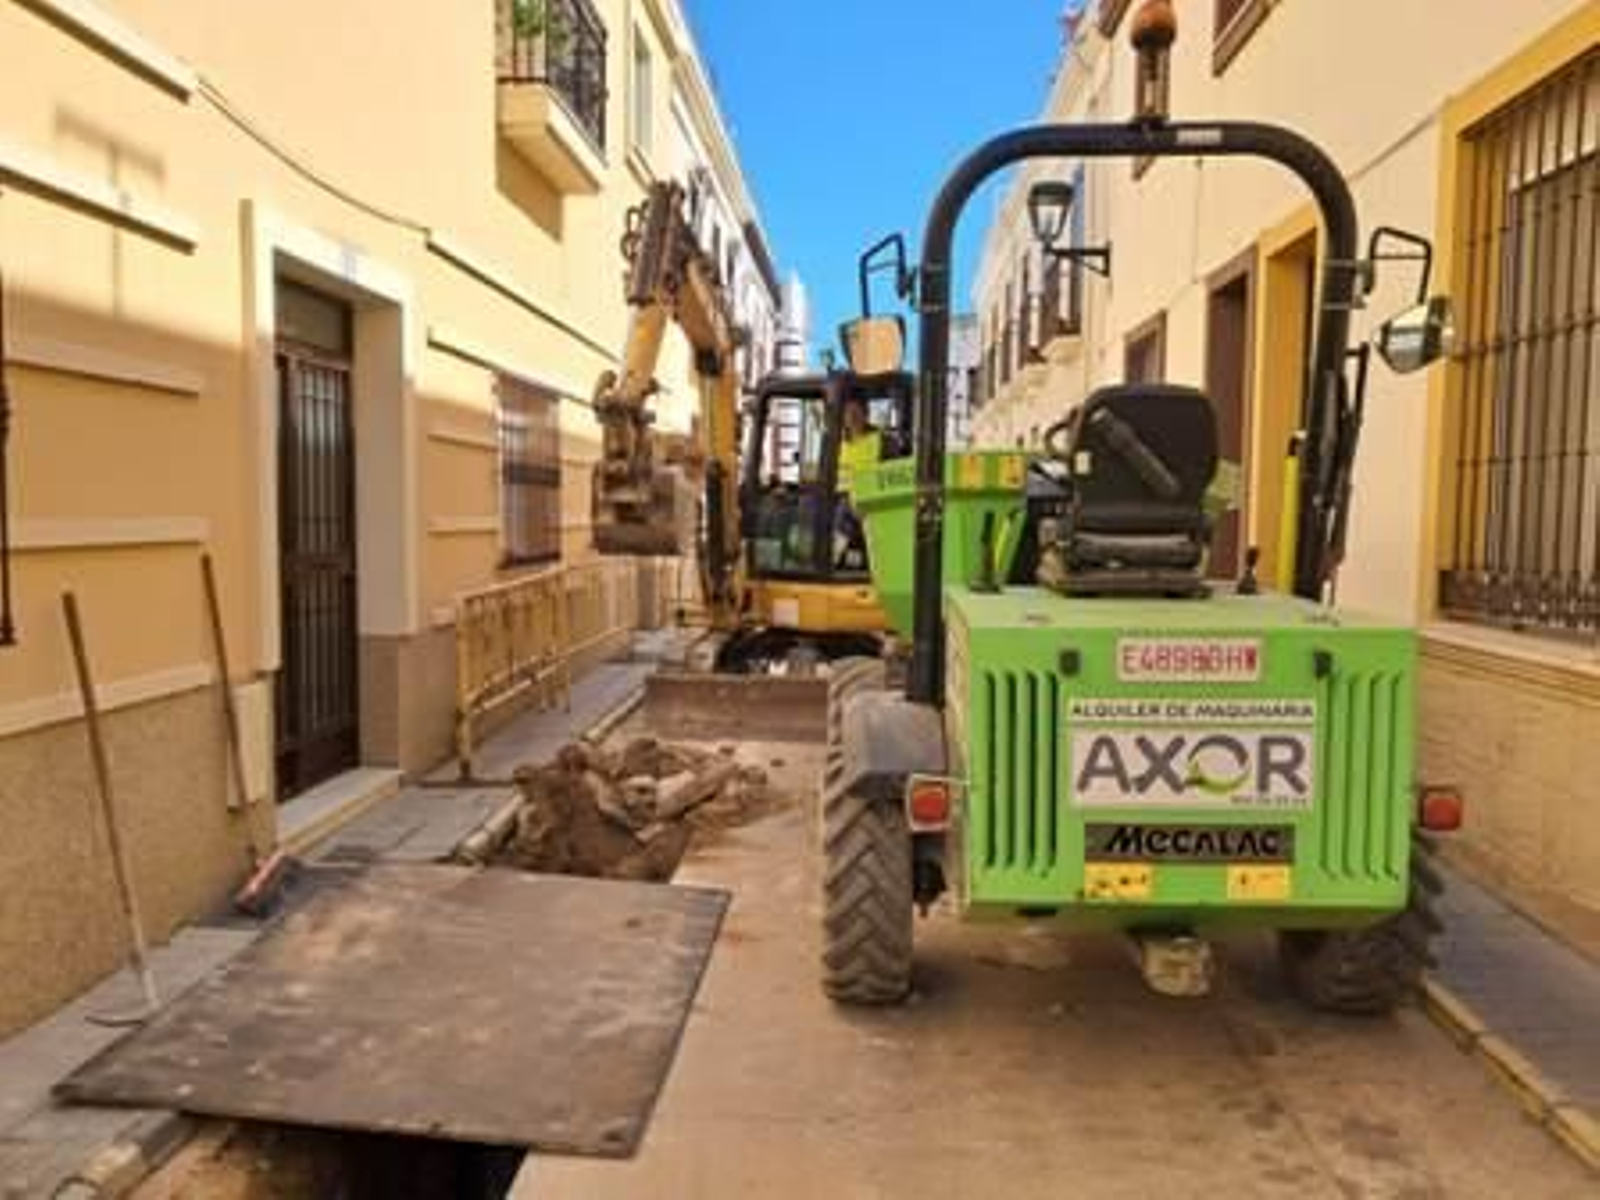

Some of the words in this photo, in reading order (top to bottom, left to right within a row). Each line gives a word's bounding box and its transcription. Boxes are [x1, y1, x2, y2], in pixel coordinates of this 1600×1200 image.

[1072, 704, 1160, 717] ALQUILER
[1166, 704, 1187, 717] DE
[1195, 704, 1314, 717] MAQUINARIA
[1076, 734, 1308, 795] AXOR
